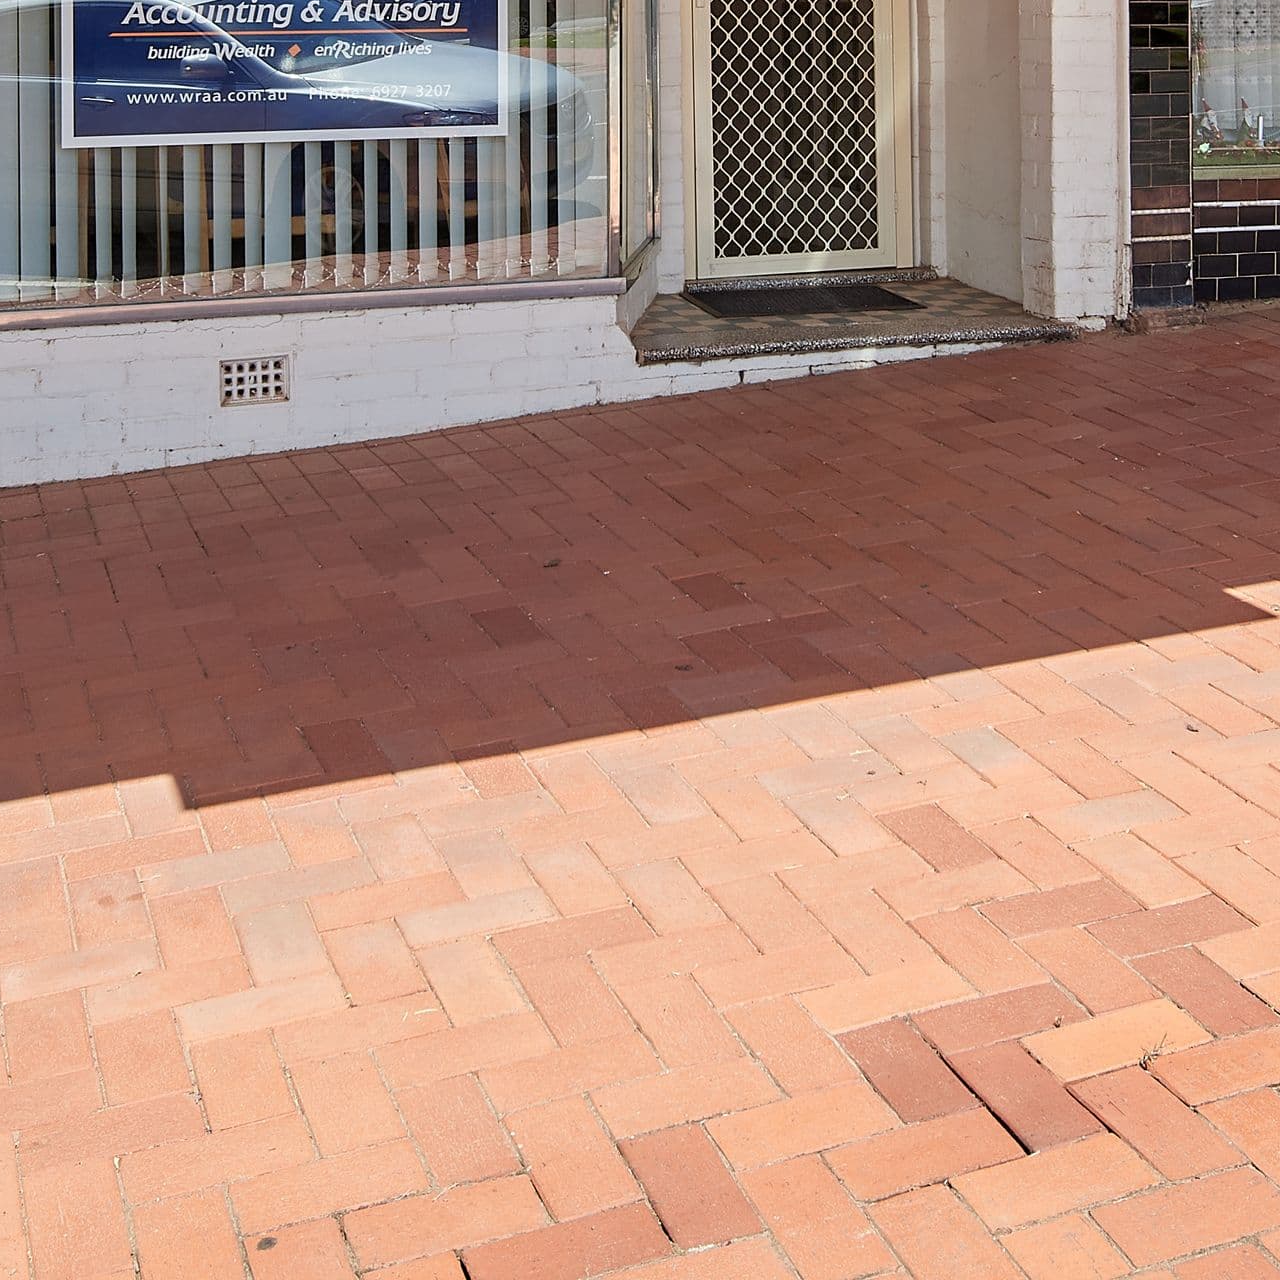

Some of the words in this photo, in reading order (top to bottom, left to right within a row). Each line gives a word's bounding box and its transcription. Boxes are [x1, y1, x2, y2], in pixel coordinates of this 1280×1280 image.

[300, 0, 324, 23] &
[147, 45, 210, 62] building
[212, 42, 276, 62] Wealth
[314, 40, 394, 59] enRiching
[398, 41, 433, 56] lives
[126, 90, 288, 105] www.wraa.com.au
[372, 85, 408, 99] 6927
[415, 84, 452, 98] 3207
